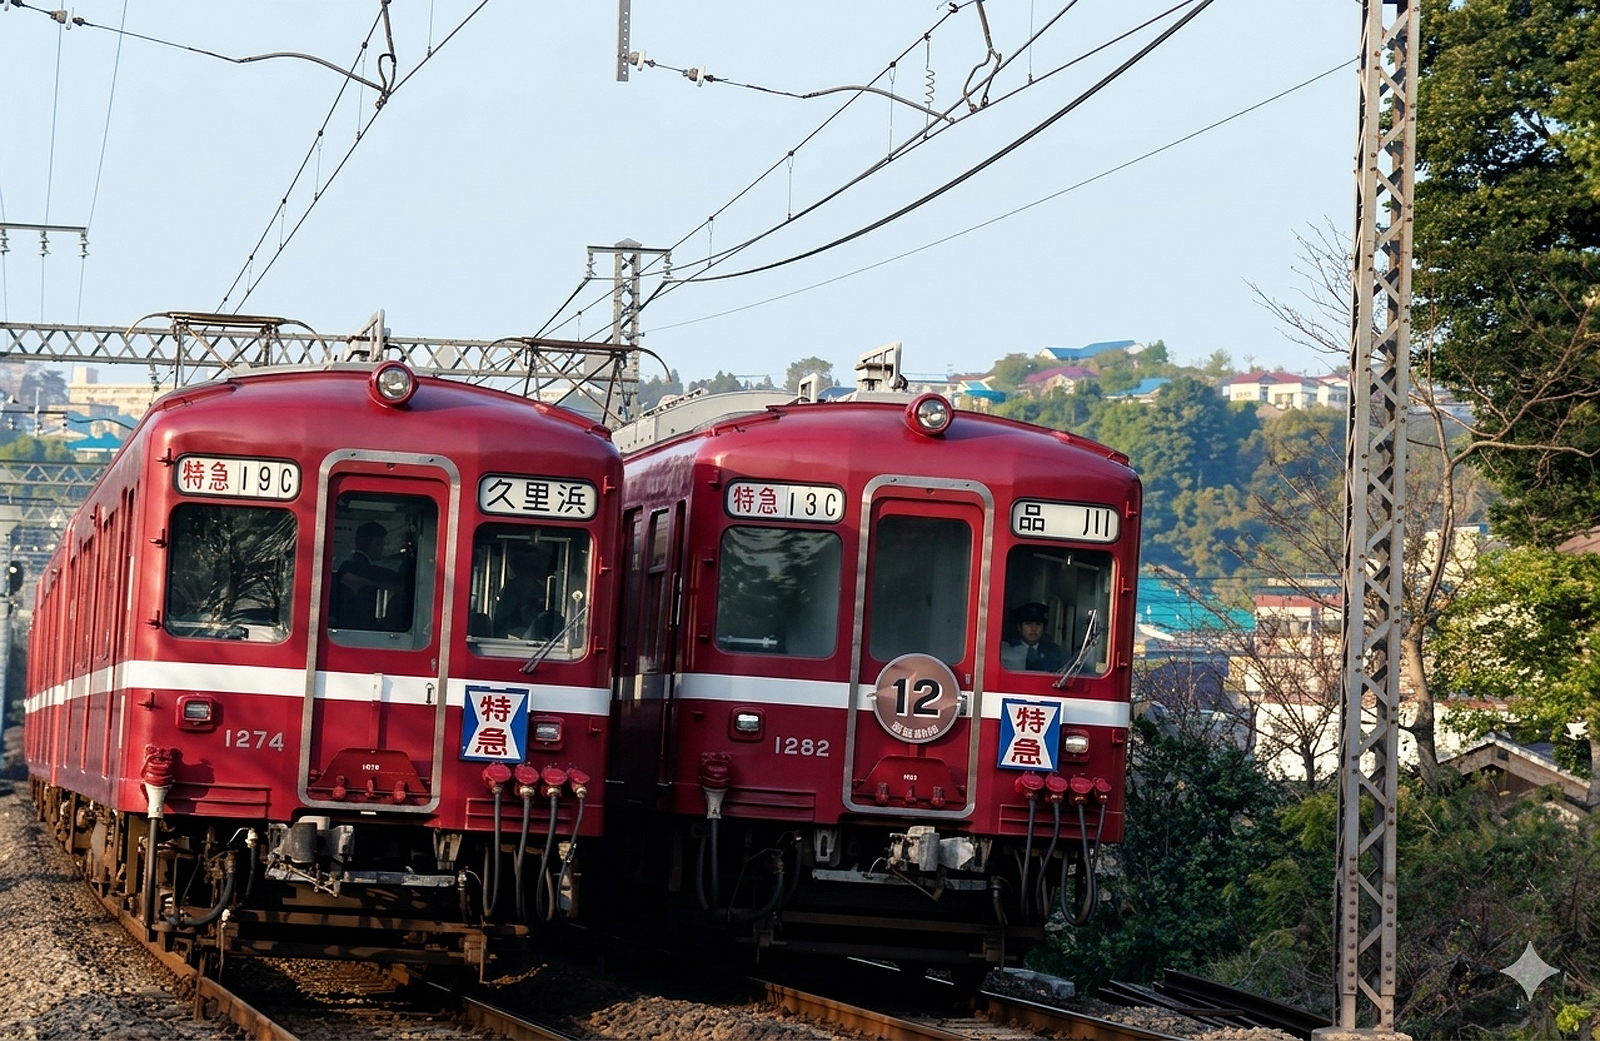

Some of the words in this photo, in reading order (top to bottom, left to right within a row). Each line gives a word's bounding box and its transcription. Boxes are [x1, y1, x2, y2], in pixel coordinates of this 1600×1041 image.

[183, 460, 229, 491] 特急
[242, 466, 292, 493] 19C
[487, 479, 586, 514] 久里浜
[733, 486, 778, 515] 特急
[790, 492, 836, 517] 13C
[892, 677, 943, 718] 12
[225, 729, 284, 752] 1274
[475, 695, 511, 756] 特急
[1011, 707, 1046, 765] 特急
[775, 736, 830, 758] 1282
